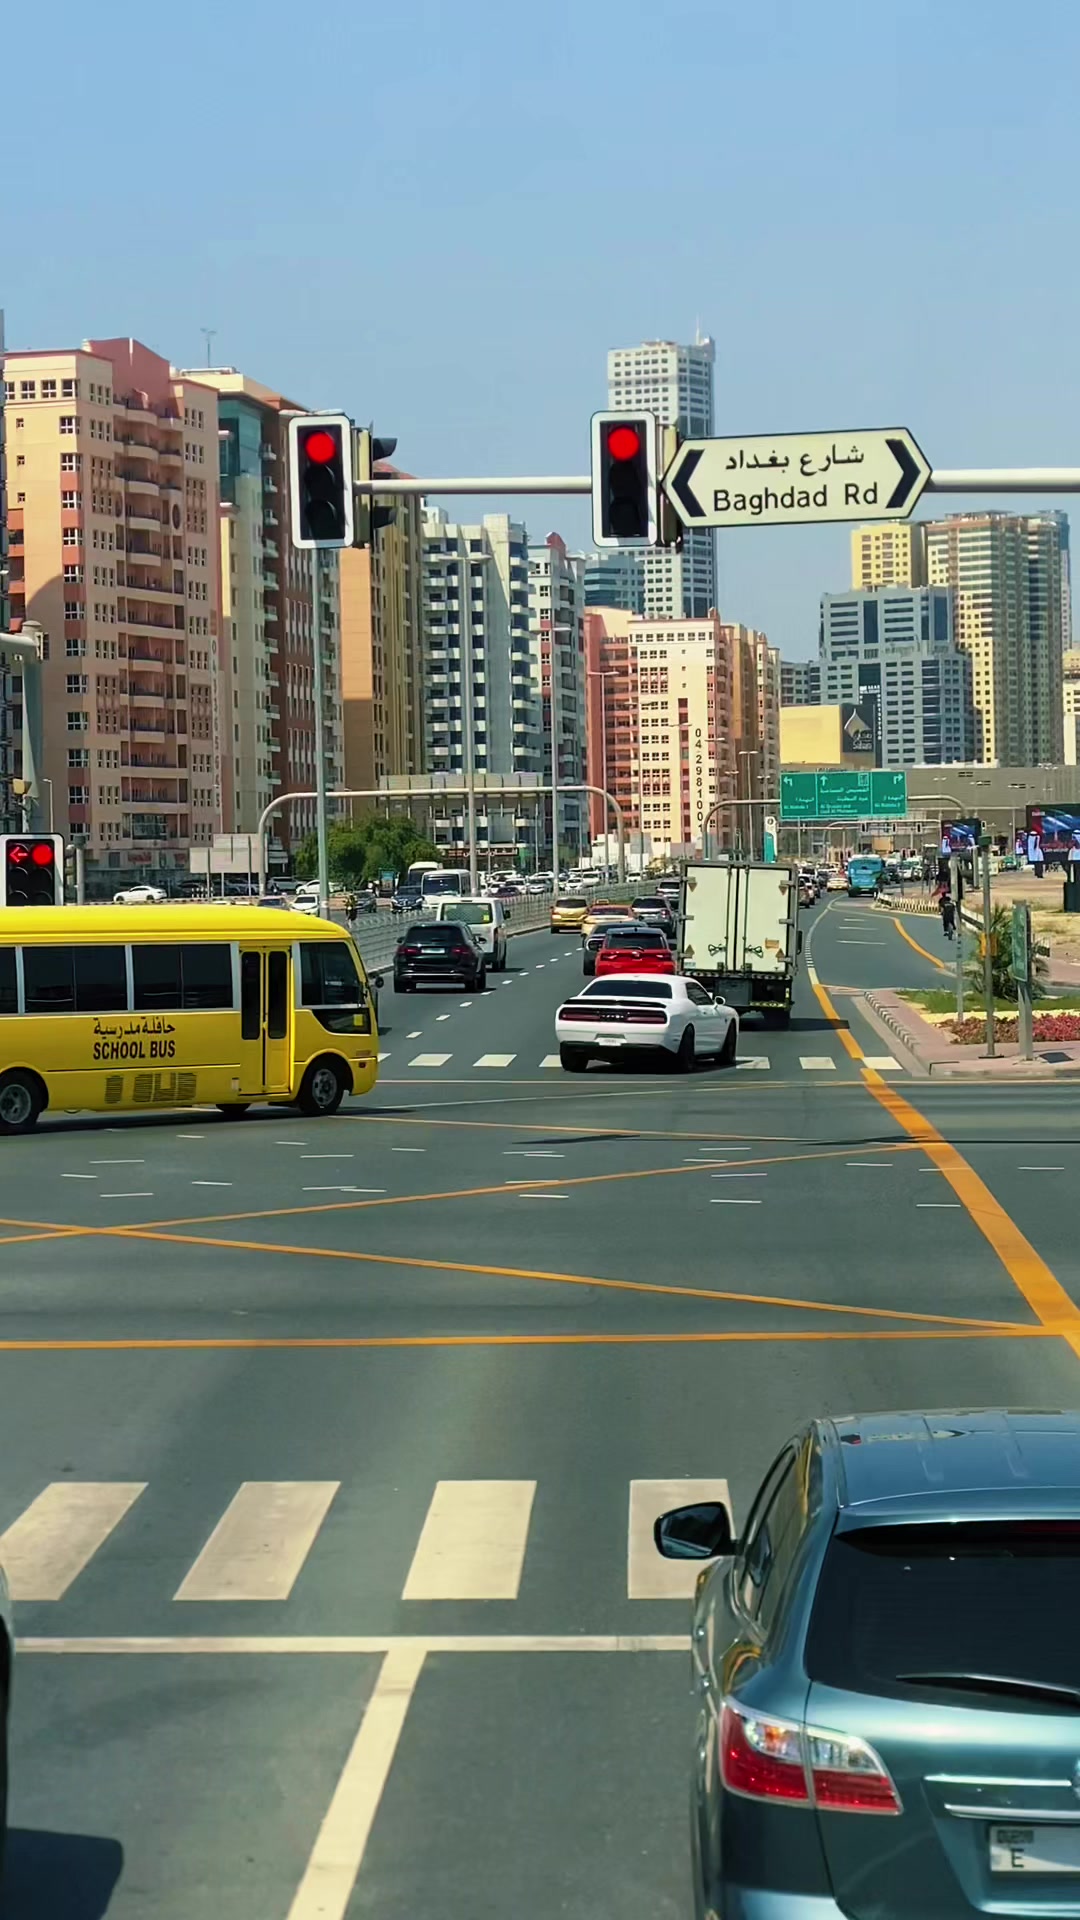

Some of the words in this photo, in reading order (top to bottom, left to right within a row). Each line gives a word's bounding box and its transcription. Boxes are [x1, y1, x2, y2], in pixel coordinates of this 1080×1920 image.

[726, 449, 790, 474] بغداد
[800, 444, 864, 476] شارع
[713, 484, 828, 515] Baghdad
[844, 481, 878, 506] Rd
[93, 1017, 141, 1039] مدرسية
[140, 1016, 176, 1035] حافلة
[93, 1041, 146, 1060] SCHOOL
[150, 1040, 176, 1058] BUS
[1011, 1848, 1024, 1868] E
